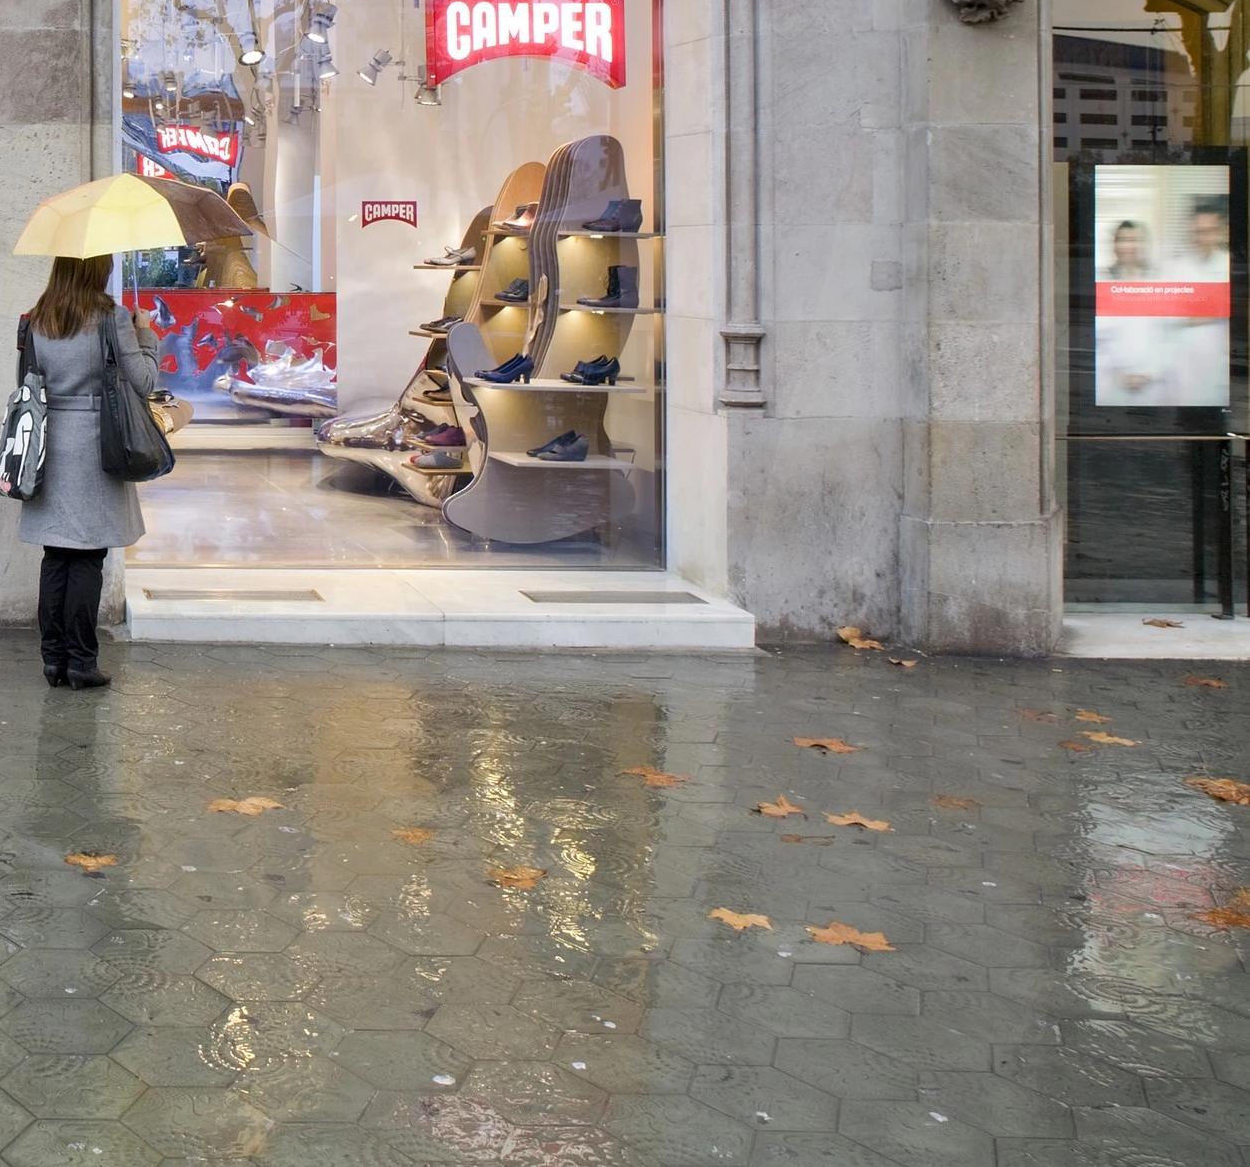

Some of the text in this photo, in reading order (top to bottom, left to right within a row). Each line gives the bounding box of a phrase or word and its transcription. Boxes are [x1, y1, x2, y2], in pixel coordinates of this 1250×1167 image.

[446, 1, 613, 61] CAMPER
[364, 203, 414, 223] CAMPER
[1164, 286, 1194, 295] projectes
